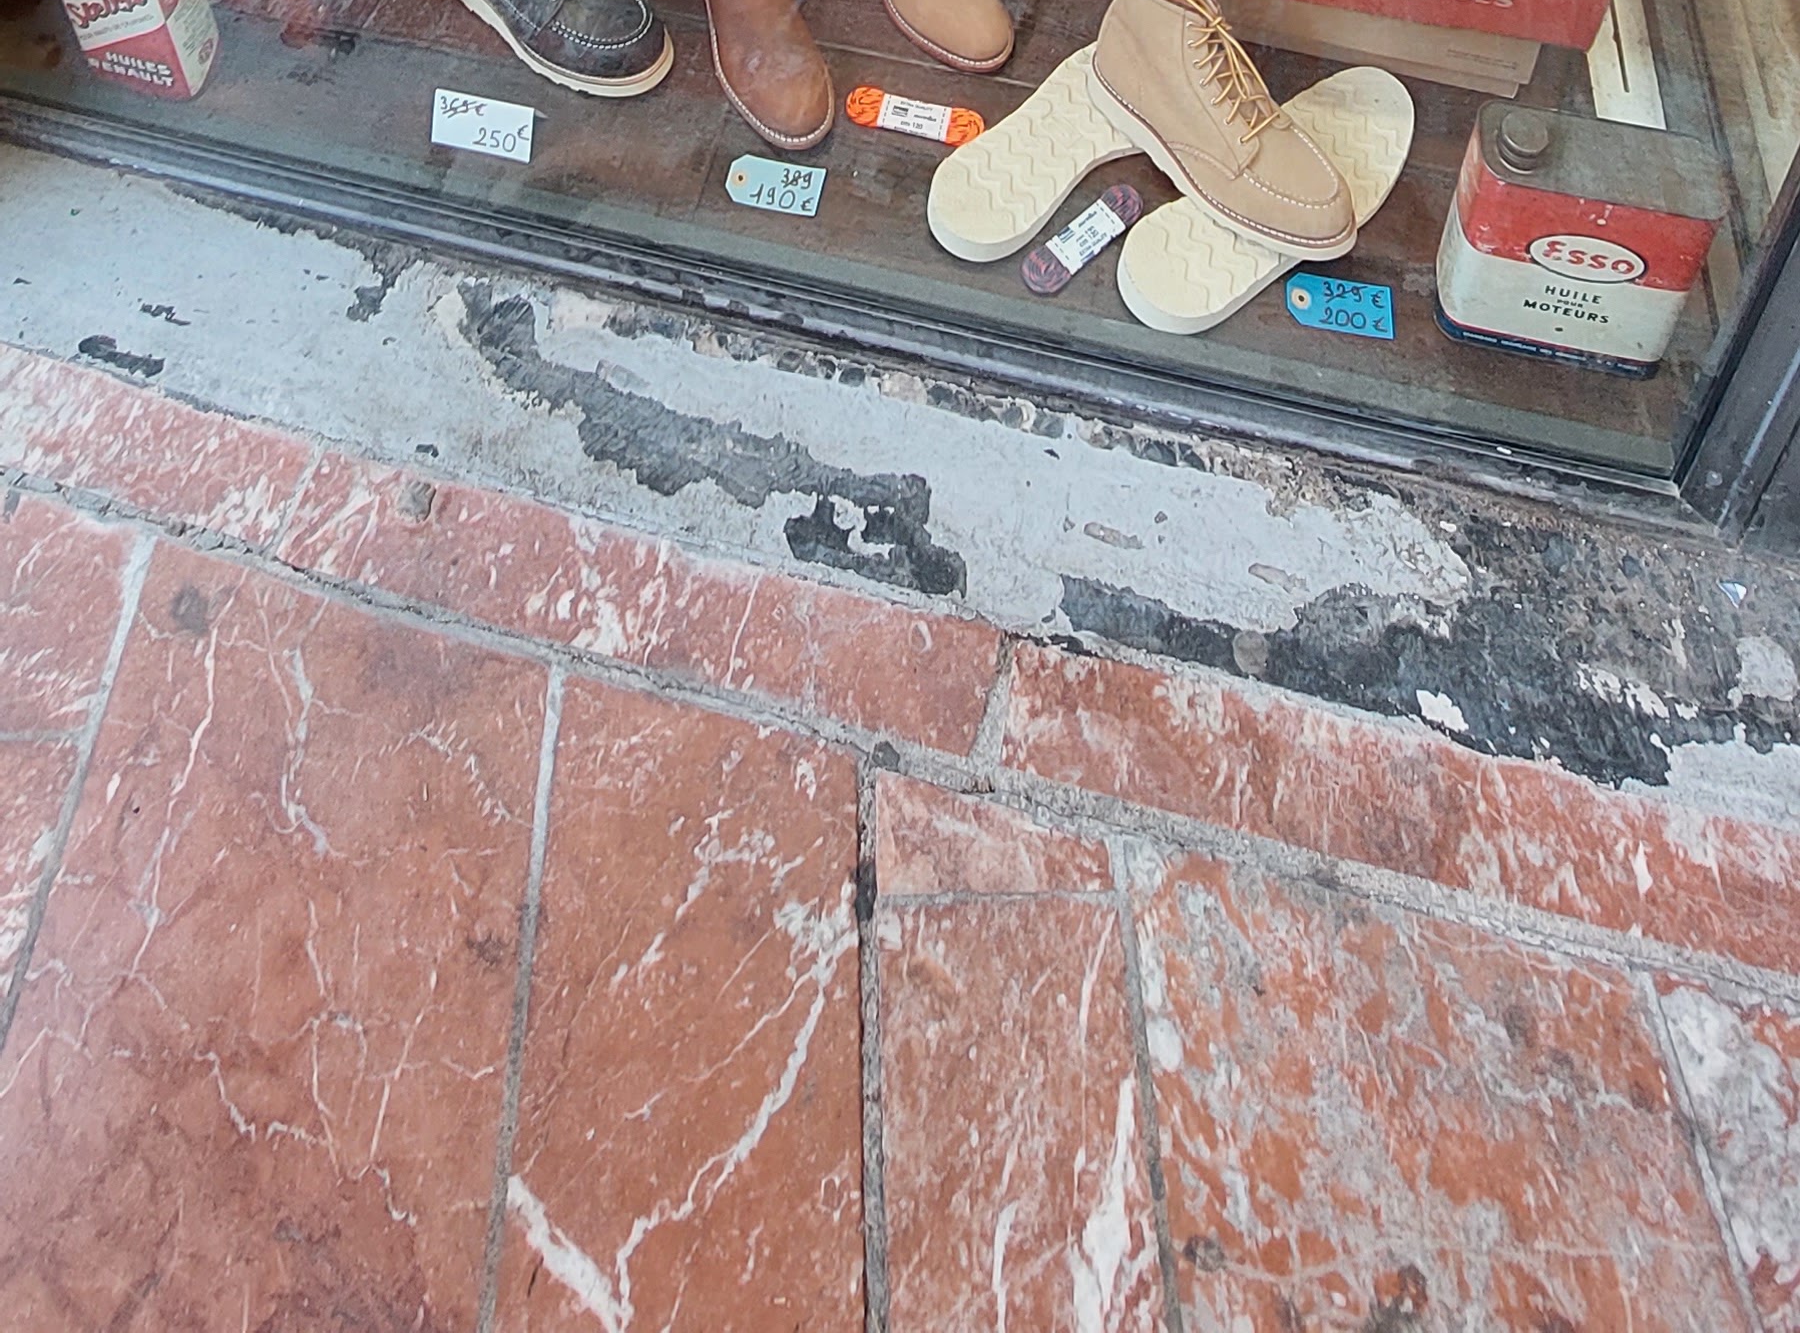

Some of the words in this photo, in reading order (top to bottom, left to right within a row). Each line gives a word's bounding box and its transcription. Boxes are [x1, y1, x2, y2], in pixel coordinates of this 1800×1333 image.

[87, 56, 175, 88] RENAULT
[105, 50, 172, 76] HUILES
[1542, 240, 1636, 276] ESSO
[1544, 285, 1603, 305] HUILE
[1549, 298, 1584, 309] POUR
[1522, 299, 1610, 324] MOTEURS
